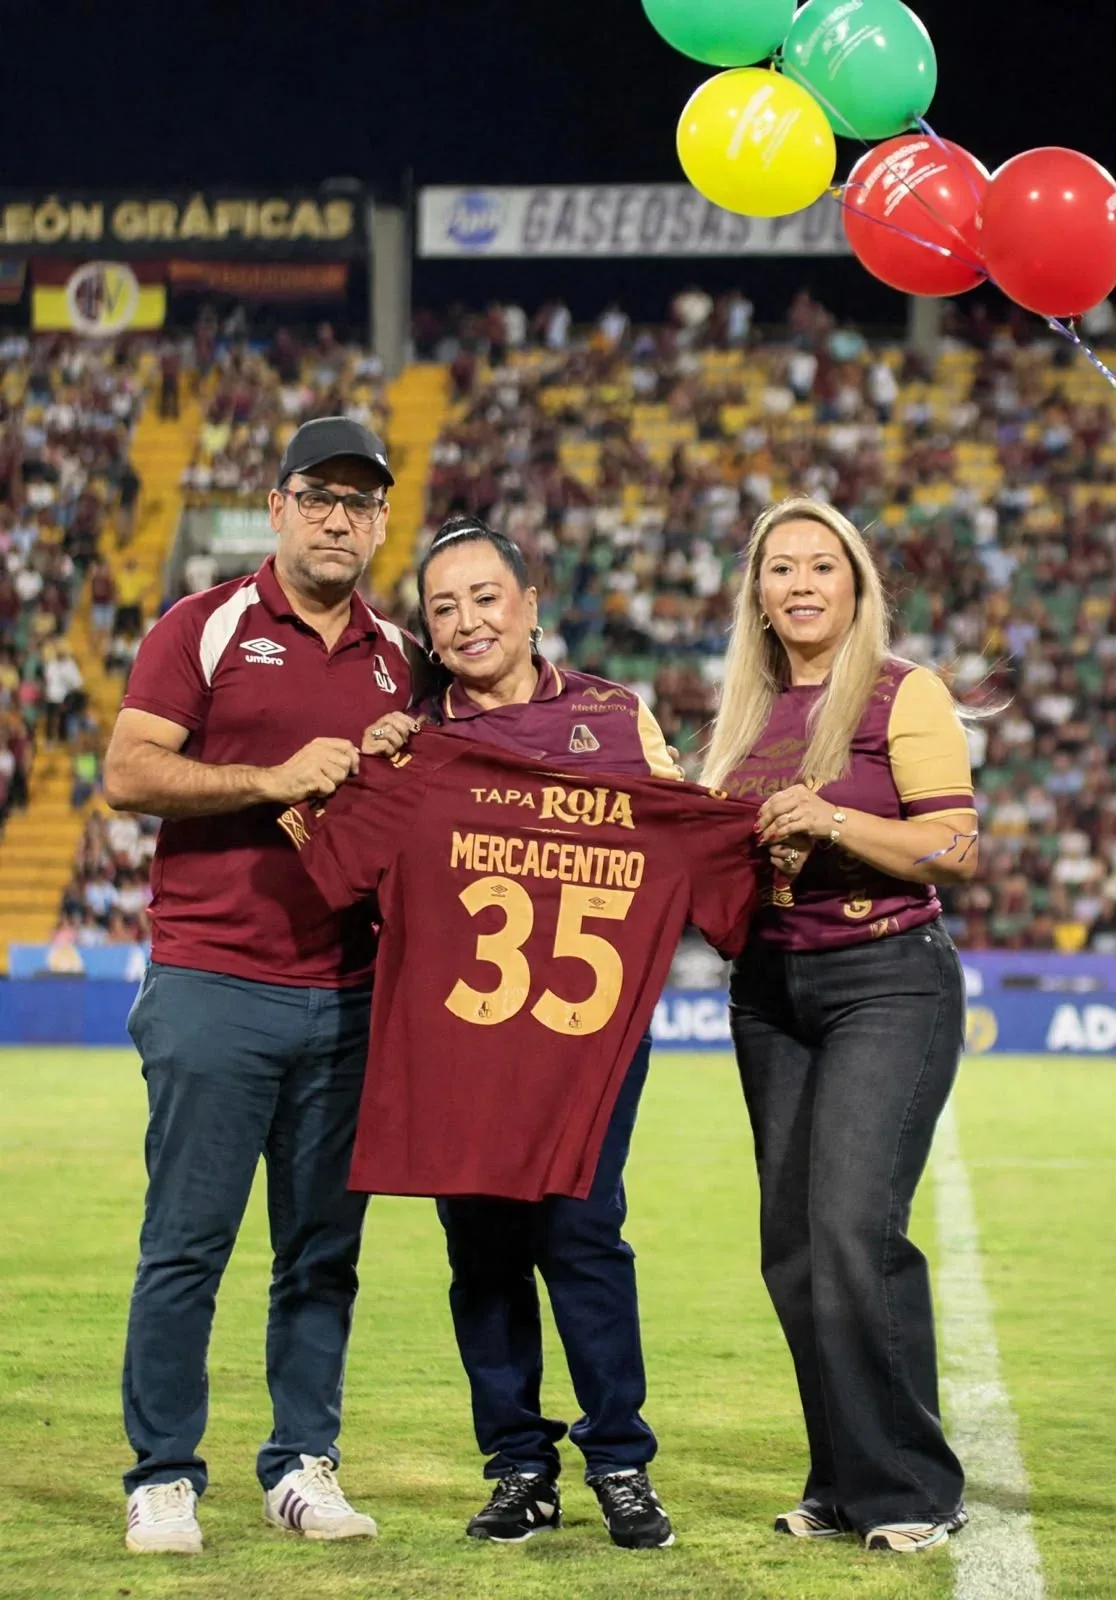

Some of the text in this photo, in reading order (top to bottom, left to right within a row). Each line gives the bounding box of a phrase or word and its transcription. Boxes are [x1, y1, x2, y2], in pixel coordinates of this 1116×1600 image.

[0, 190, 354, 243] EÓN GRÁFICAS
[521, 188, 751, 245] GASEOSAS
[245, 654, 284, 666] umbro
[470, 786, 636, 830] TAPA ROJA
[450, 831, 645, 889] MERCACENTRO
[444, 875, 636, 1036] 35
